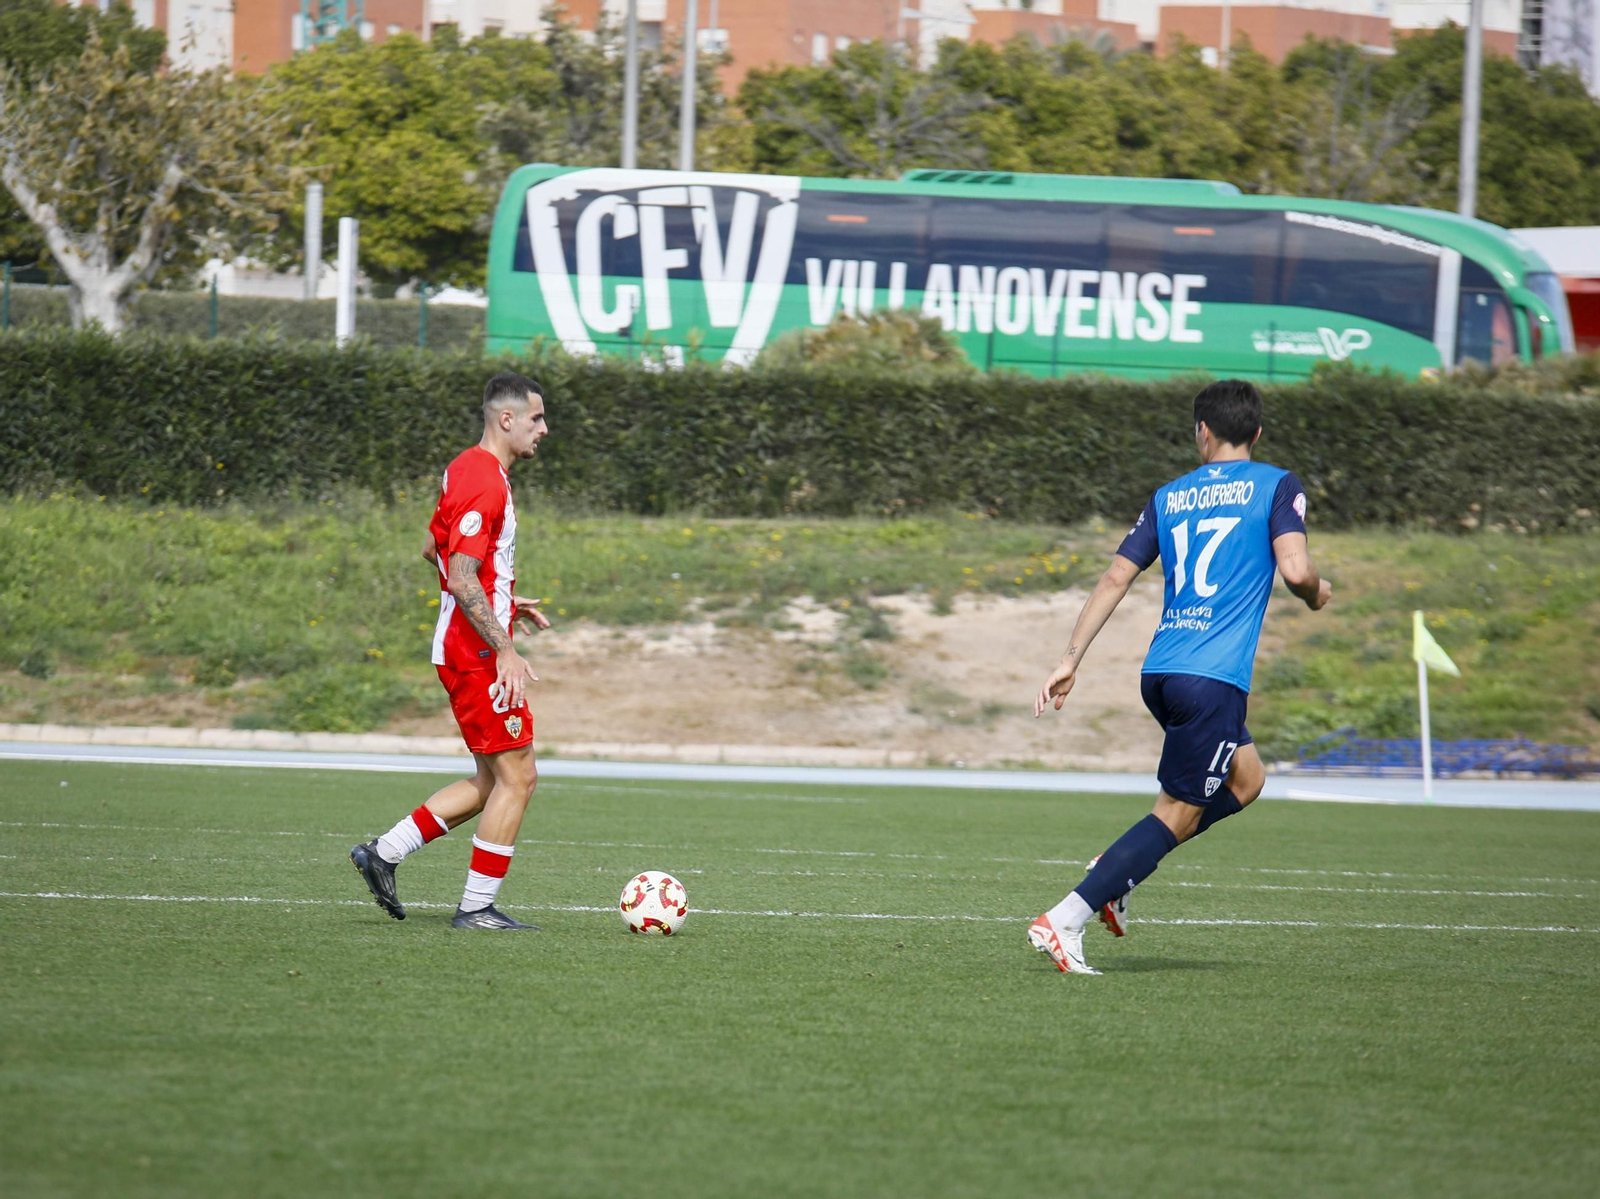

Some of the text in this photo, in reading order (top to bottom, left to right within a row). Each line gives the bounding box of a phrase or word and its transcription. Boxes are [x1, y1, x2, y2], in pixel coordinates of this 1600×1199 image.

[576, 186, 760, 333] CFV
[805, 258, 1207, 343] VILLANOVENSE
[1165, 480, 1254, 515] PABLO GUERRERO
[1171, 516, 1242, 598] 17
[1207, 740, 1238, 774] 17
